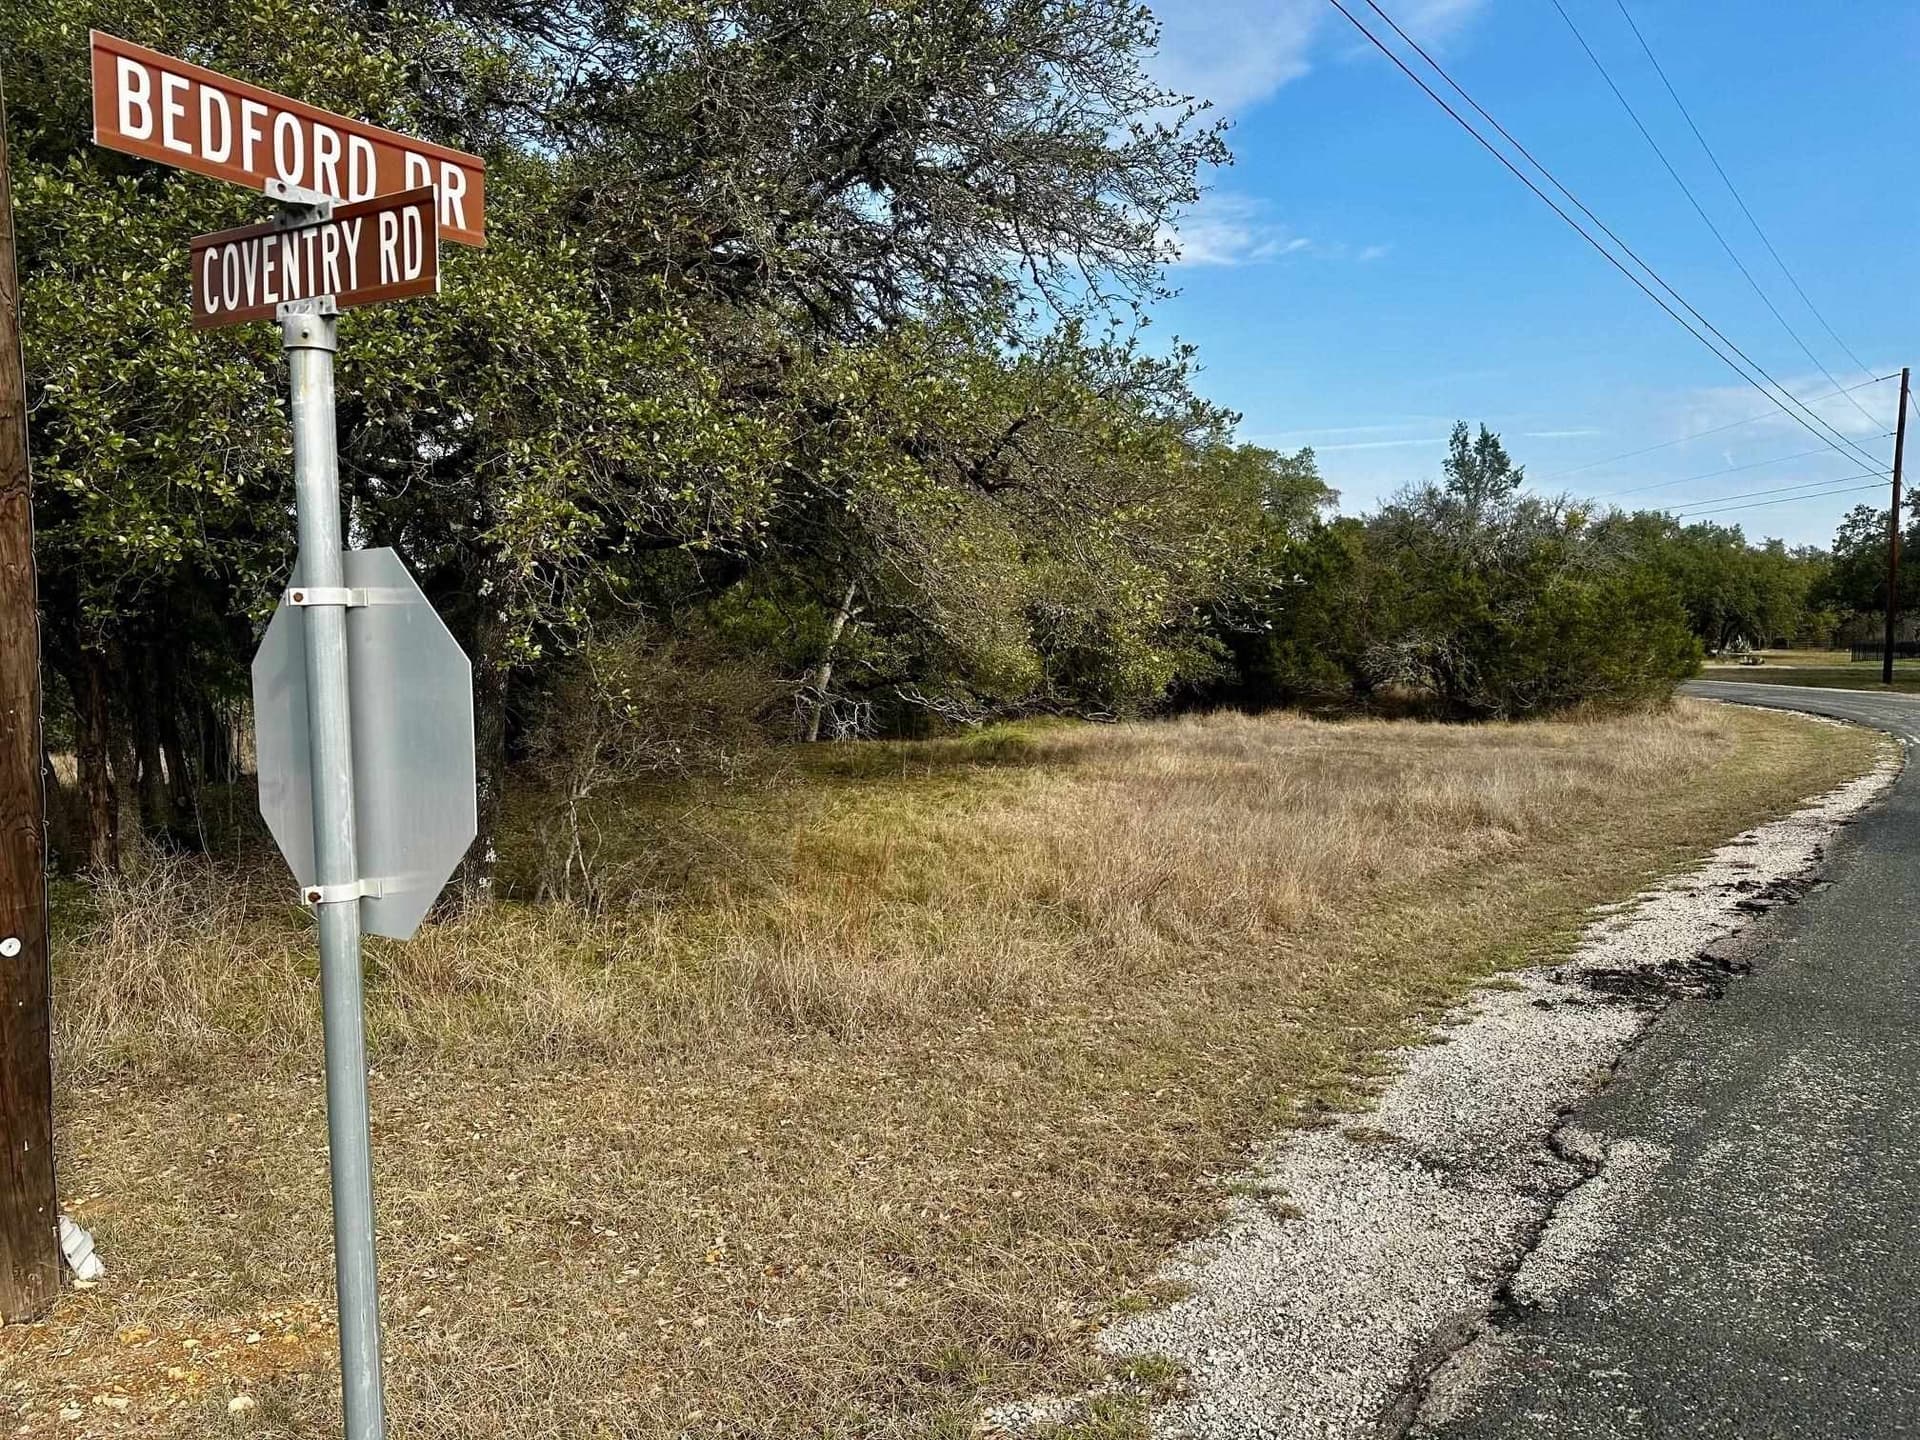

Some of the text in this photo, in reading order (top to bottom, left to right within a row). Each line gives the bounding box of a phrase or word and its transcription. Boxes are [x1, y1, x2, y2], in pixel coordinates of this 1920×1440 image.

[117, 56, 467, 231] BEDFORD DR
[203, 205, 423, 314] COVENTRY RD
